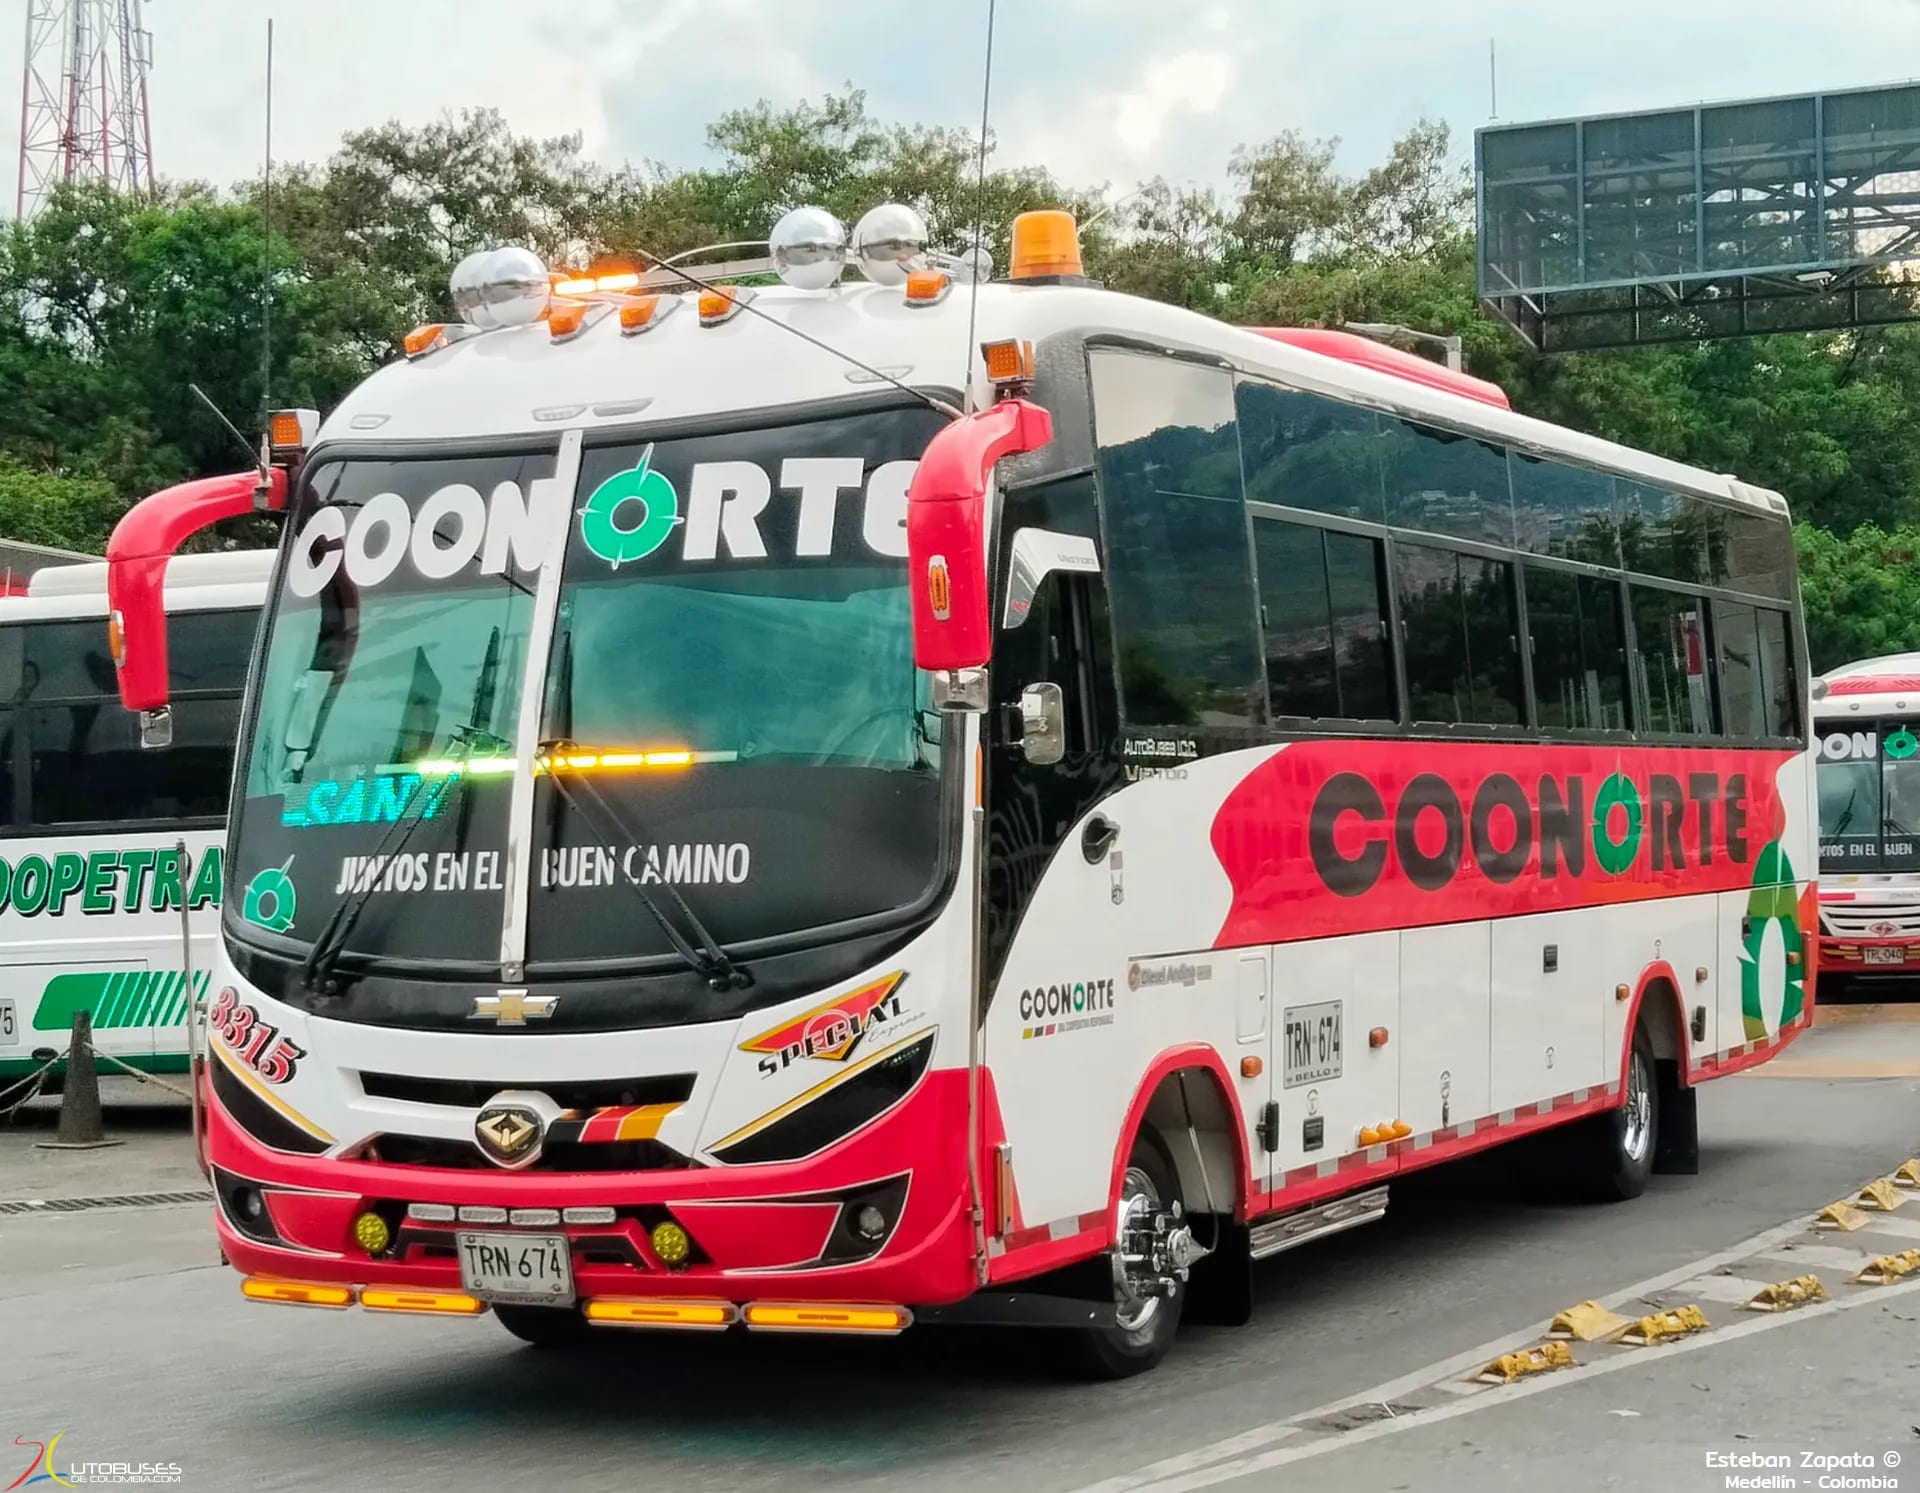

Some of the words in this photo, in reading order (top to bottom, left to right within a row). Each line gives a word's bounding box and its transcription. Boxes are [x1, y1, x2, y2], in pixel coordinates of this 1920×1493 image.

[1308, 756, 1748, 898] COONORTE
[0, 846, 224, 917] OPETRA
[335, 852, 429, 895] JUNTOS
[433, 851, 470, 892] EN
[474, 850, 503, 891] EL
[540, 846, 616, 887] BUEN
[622, 843, 750, 886] CAMINO
[1020, 978, 1114, 1021] COONORTE
[210, 985, 307, 1084] 3315
[758, 998, 910, 1081] SPECIAL
[1286, 1018, 1311, 1070] TRN
[1318, 1014, 1341, 1064] 674
[1295, 1067, 1331, 1083] BELLO
[464, 1245, 511, 1278] TRN
[518, 1247, 562, 1279] 674
